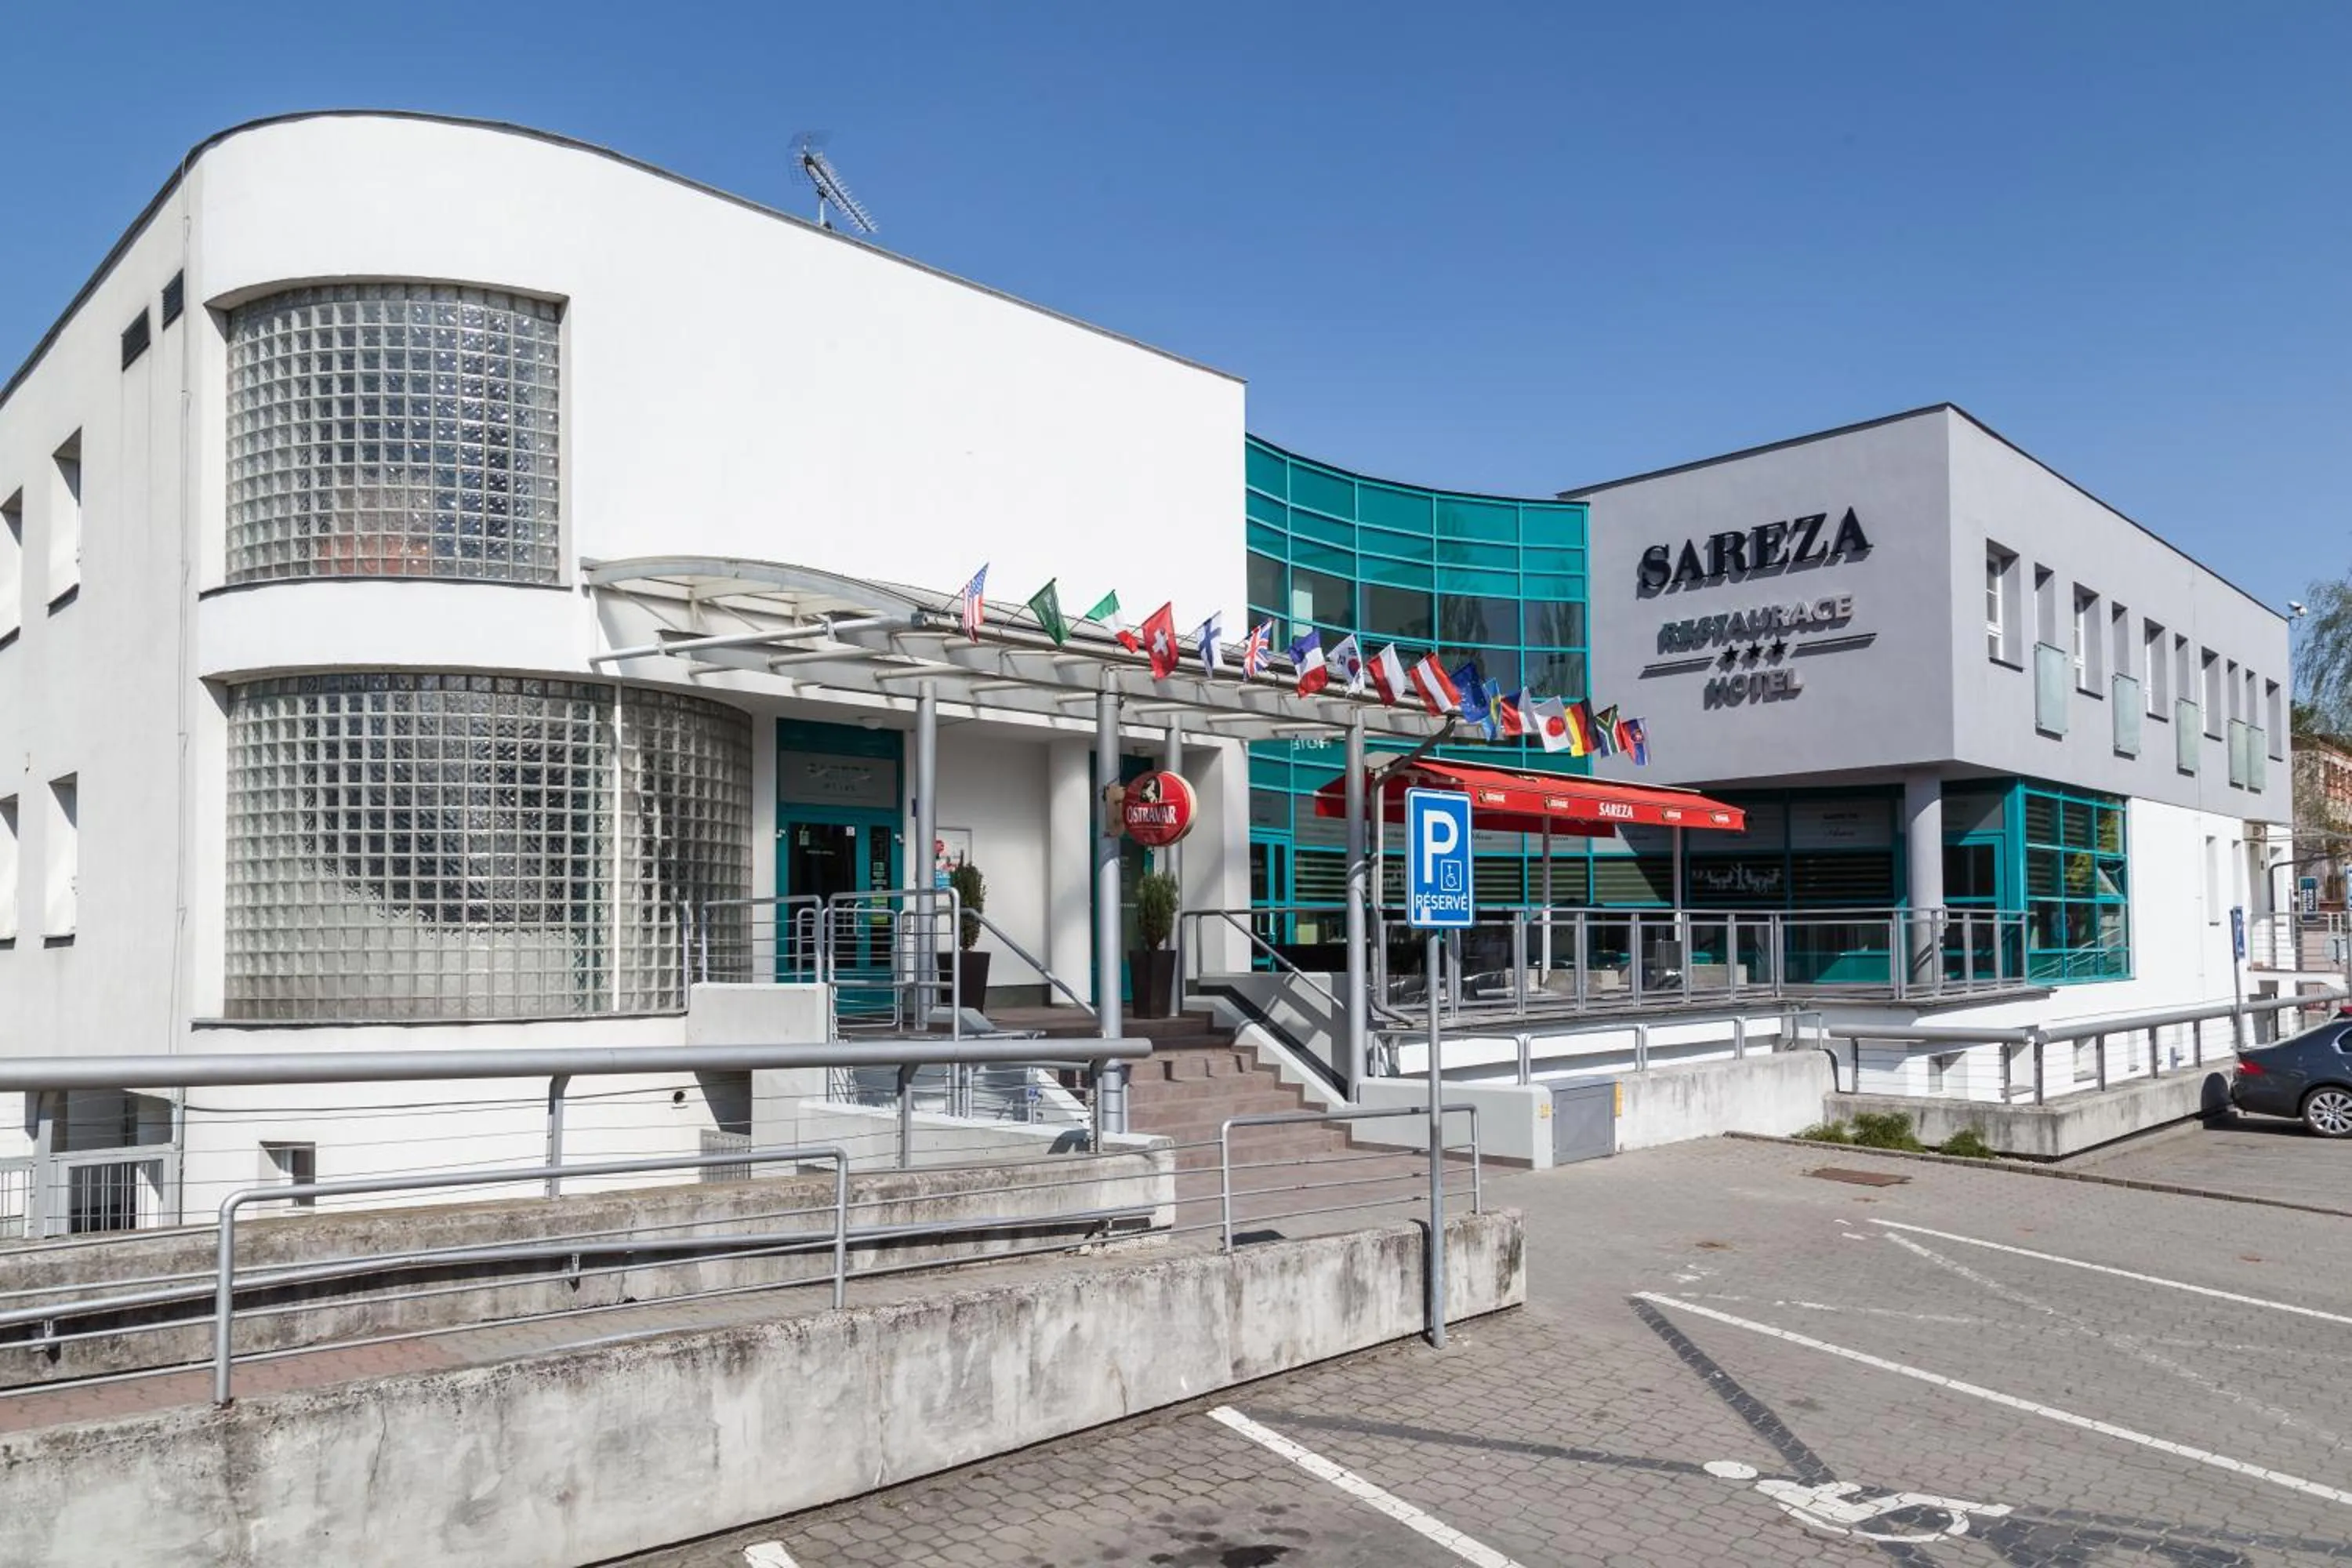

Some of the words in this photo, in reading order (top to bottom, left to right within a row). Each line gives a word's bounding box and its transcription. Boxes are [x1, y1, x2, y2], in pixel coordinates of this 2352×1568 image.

[1639, 506, 1874, 590] SAREZA
[1657, 593, 1853, 653] RESTAURACE
[1704, 668, 1802, 710] HOTEL
[1127, 805, 1177, 824] OSTRAVAR
[1599, 802, 1634, 818] SAREZA
[1423, 809, 1458, 884] P
[1415, 891, 1468, 911] RÉSERVÉ
